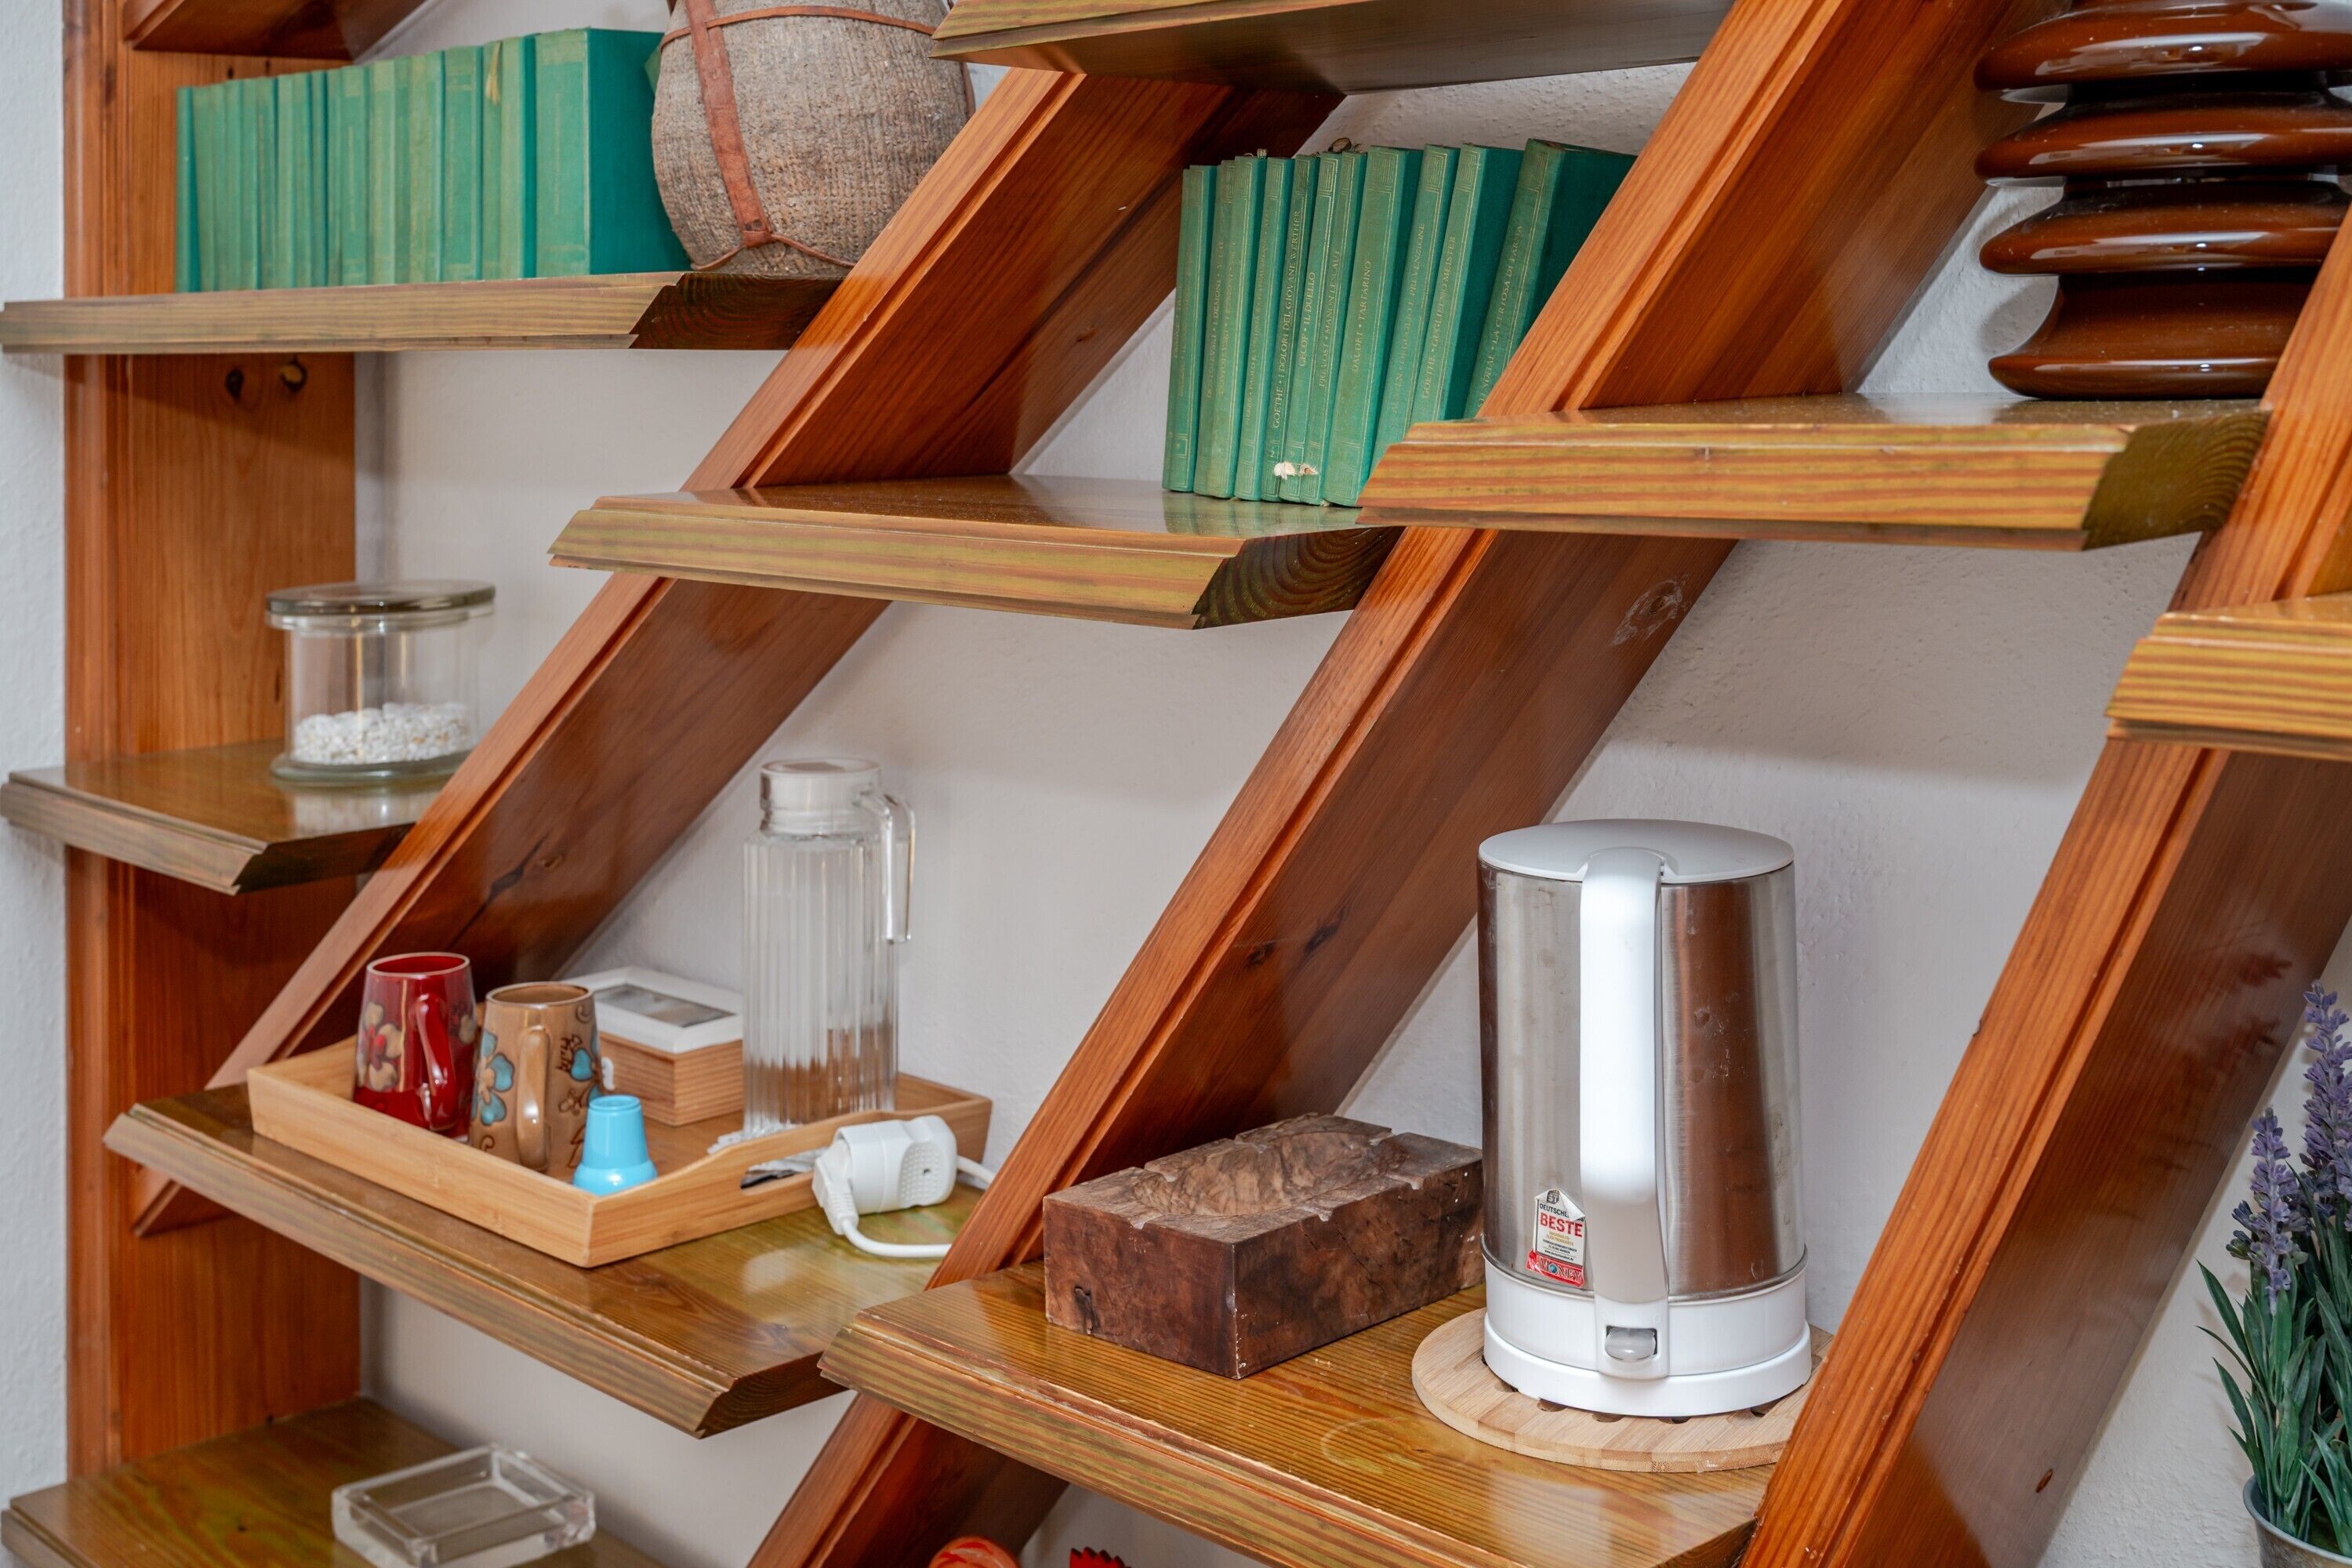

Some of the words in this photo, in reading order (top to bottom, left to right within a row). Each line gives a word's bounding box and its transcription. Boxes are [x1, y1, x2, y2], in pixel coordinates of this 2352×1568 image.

[1288, 210, 1301, 260] WERTHER
[1409, 223, 1425, 296] PREVENZIONE
[1505, 265, 1514, 278] DI
[1284, 263, 1296, 309] GIOVANE
[1304, 271, 1316, 312] DUELLO
[1495, 281, 1510, 328] CERTOSA
[1283, 311, 1292, 331] DEL
[1303, 315, 1310, 325] IL
[1352, 332, 1363, 372] DAUDET
[1359, 260, 1372, 321] TARTARINO
[1422, 355, 1436, 399] GOETHE
[1429, 284, 1447, 347] GUGLIELMO
[1443, 236, 1456, 282] MEISTER
[1279, 333, 1289, 372] DOLORI
[1319, 343, 1330, 387] PREVOST
[1325, 296, 1336, 334] MANON
[1492, 331, 1500, 344] LA
[1272, 387, 1283, 429] GOETHE
[1540, 1212, 1583, 1237] BESTE
[1539, 1257, 1582, 1280] MONEY
